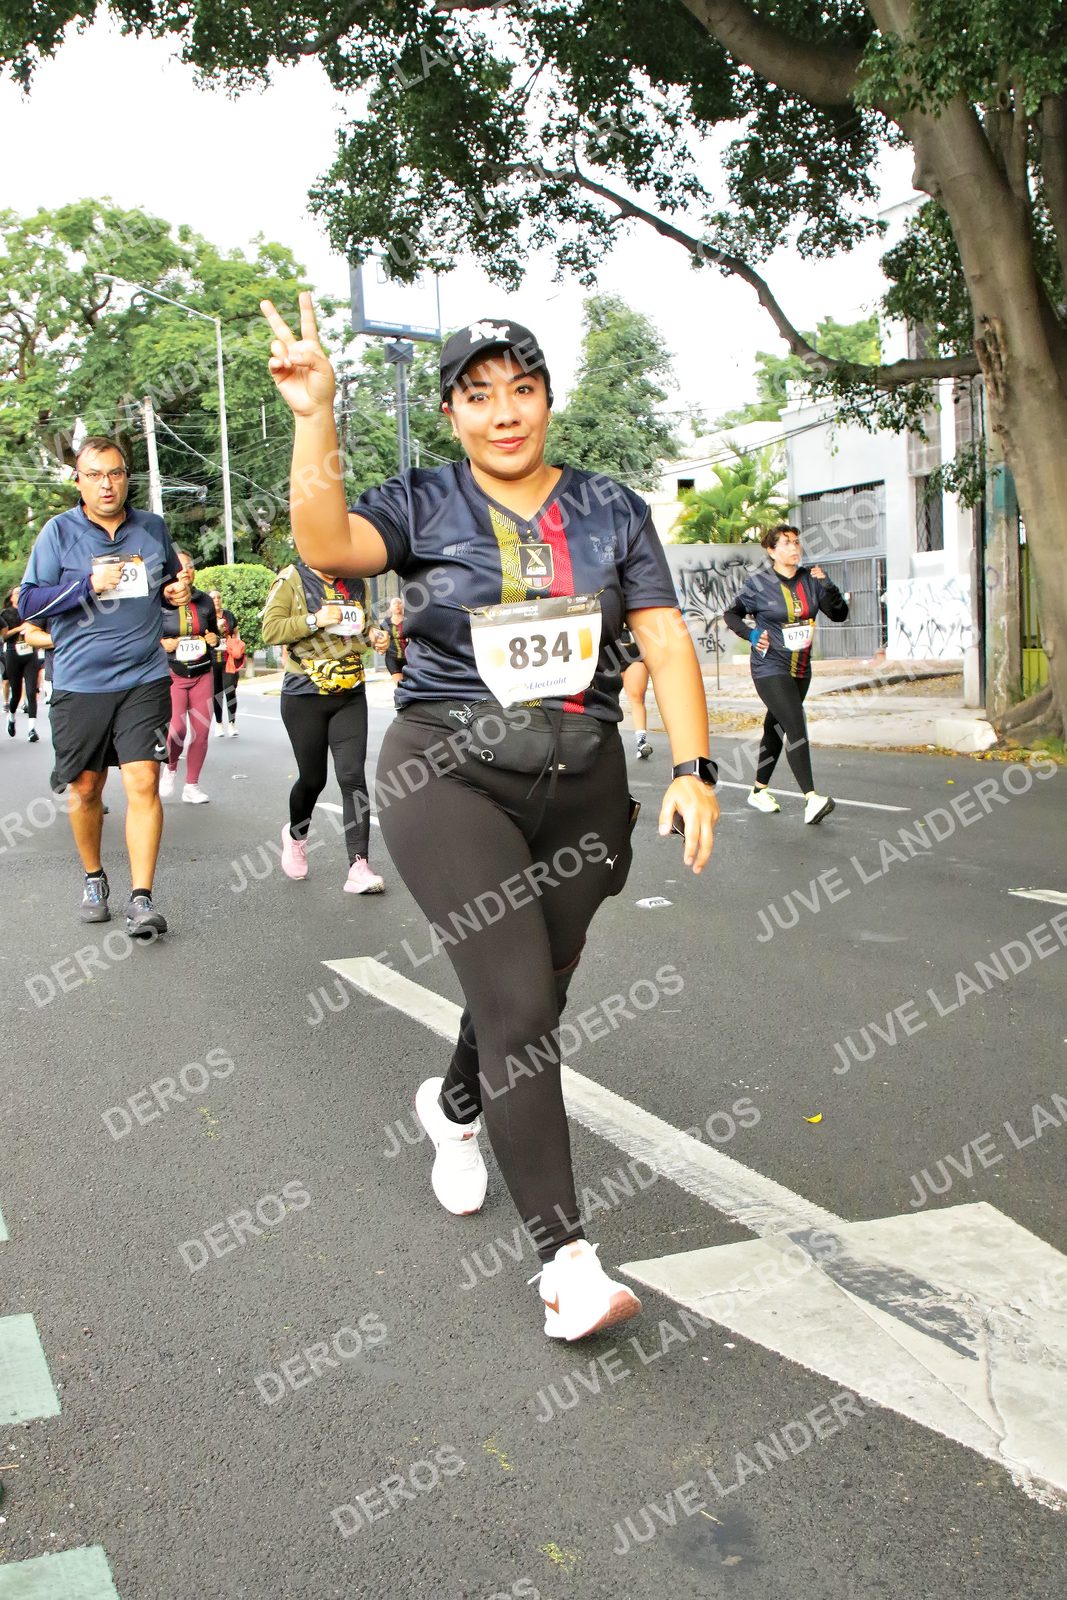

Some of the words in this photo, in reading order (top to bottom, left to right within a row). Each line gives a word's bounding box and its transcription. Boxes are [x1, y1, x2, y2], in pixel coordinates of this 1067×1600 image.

[788, 630, 810, 641] 6797
[180, 643, 200, 652] 1736
[508, 631, 573, 669] 834
